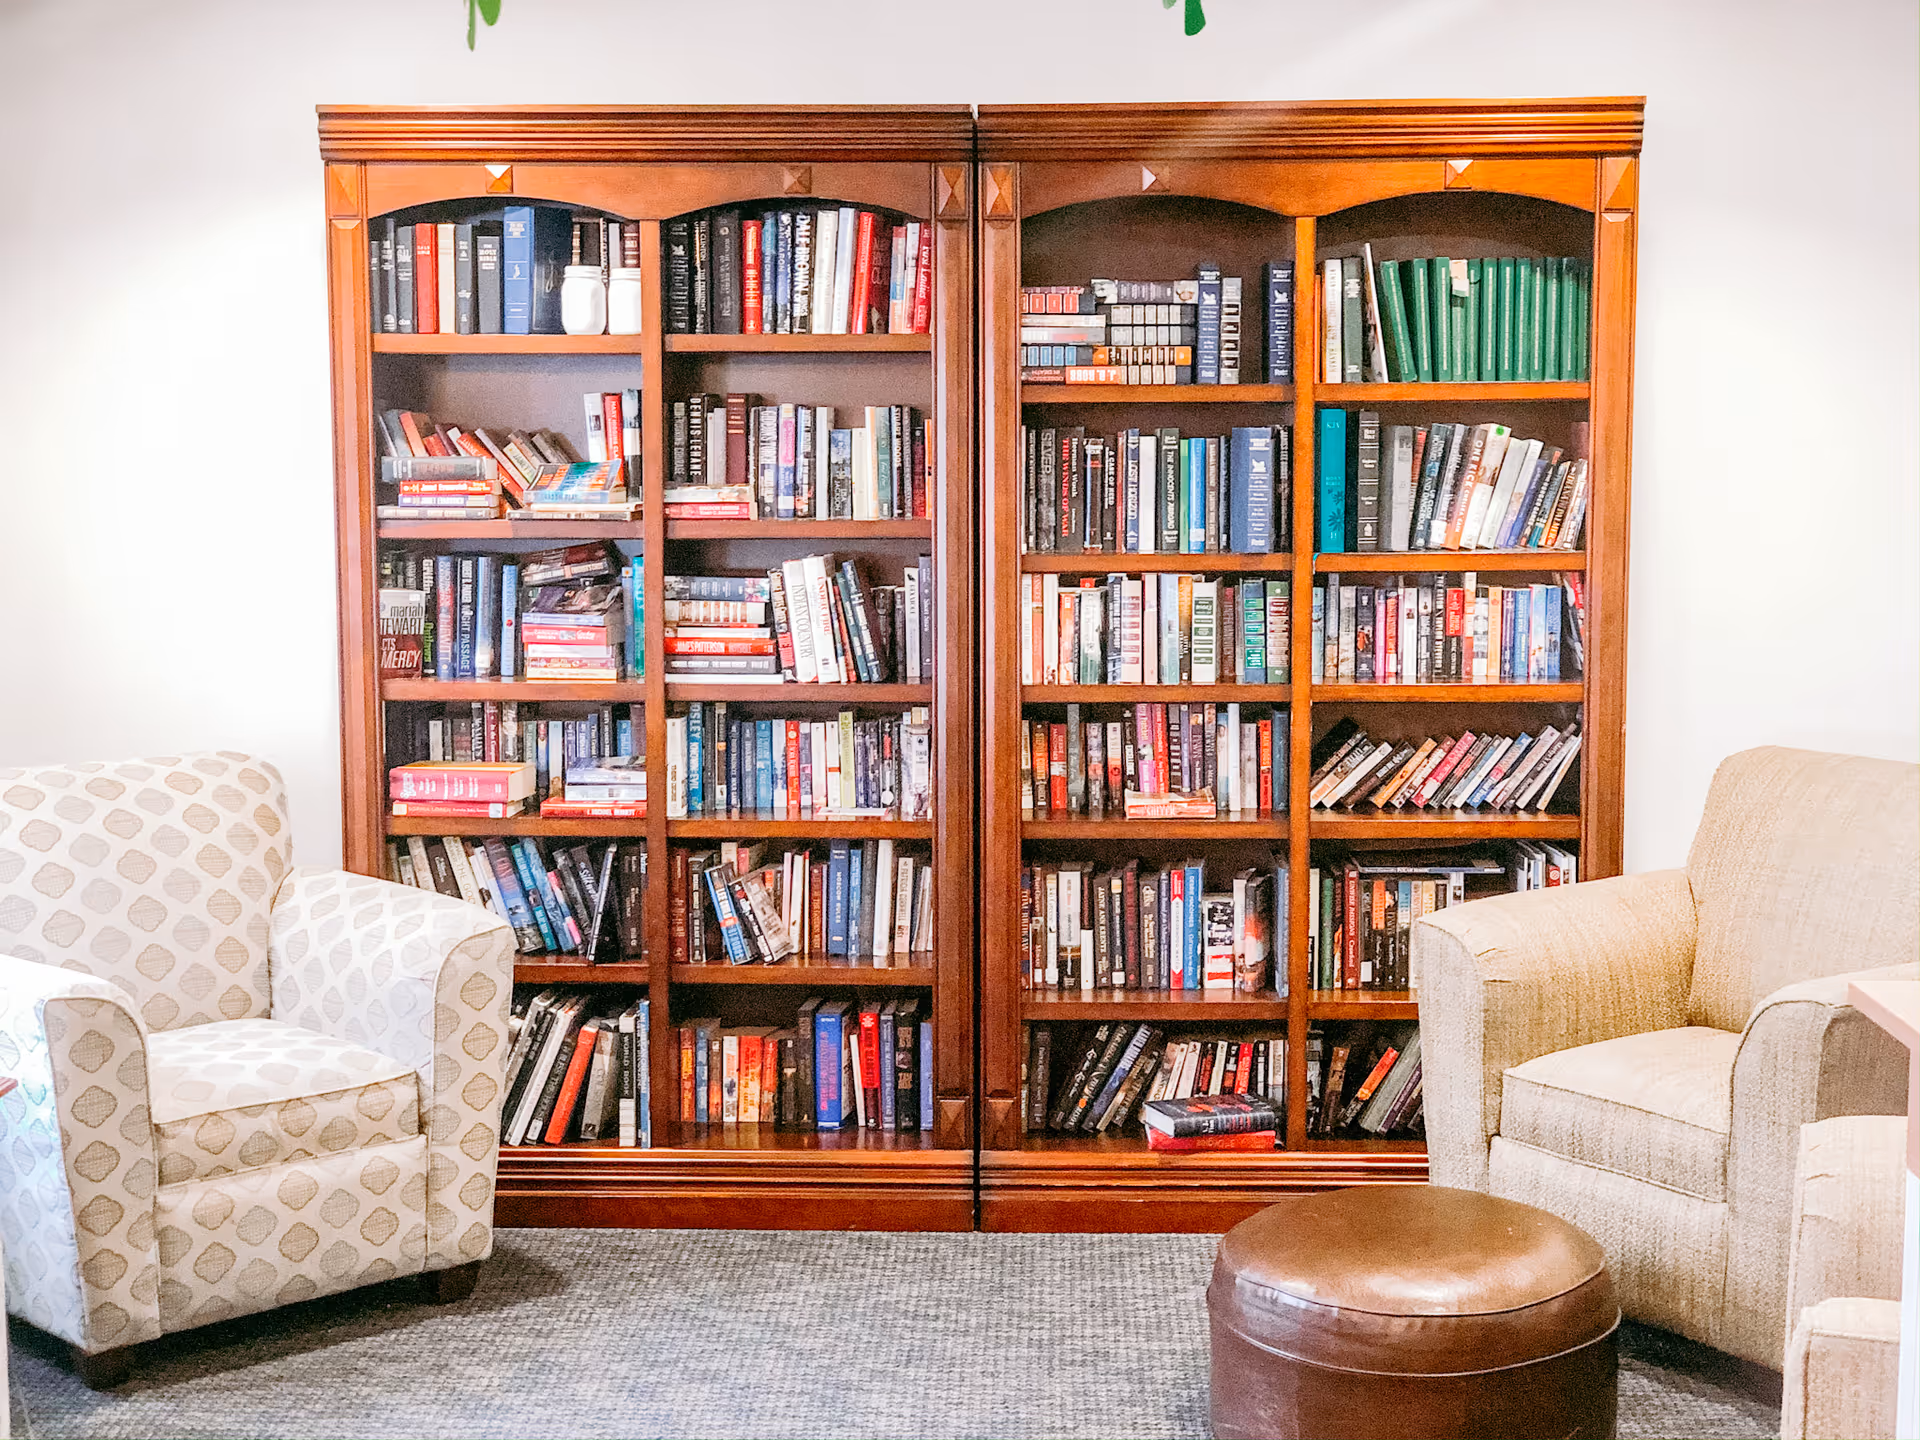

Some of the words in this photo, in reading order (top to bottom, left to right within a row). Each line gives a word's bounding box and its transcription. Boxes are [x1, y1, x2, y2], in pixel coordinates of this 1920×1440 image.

[796, 216, 811, 243] DALE
[795, 247, 810, 291] BROWN
[919, 268, 931, 300] Ladies
[1070, 369, 1096, 382] ROBB
[610, 401, 618, 418] MARY
[690, 398, 702, 436] DENNIS
[690, 439, 702, 476] LEHANE
[1040, 432, 1052, 474] SILVER
[1167, 451, 1176, 463] THE
[1280, 450, 1288, 460] LEE
[1472, 440, 1484, 461] ONE
[1128, 460, 1138, 483] LOST
[1167, 464, 1176, 501] INNOCENTS
[1424, 477, 1432, 492] AND
[1464, 464, 1478, 488] KICK
[1560, 474, 1575, 500] DIANA
[1062, 494, 1069, 511] OF
[1128, 486, 1138, 520] HORIZON
[1418, 492, 1430, 531] DANGEROUS
[1426, 500, 1434, 519] CLOSE
[1459, 489, 1470, 516] CHELSEA
[1166, 502, 1176, 530] ABROAD
[1548, 508, 1565, 539] PALMER
[461, 560, 474, 578] ROBERT
[1436, 576, 1444, 586] THE
[461, 584, 473, 603] PARKER
[792, 584, 808, 616] INDIAN
[817, 576, 828, 611] UNDER
[390, 603, 422, 618] mariah
[460, 604, 474, 632] NIGHT
[822, 614, 832, 636] FIRE
[1436, 616, 1444, 639] TAYLOR
[423, 622, 434, 663] Outlaws
[460, 634, 470, 670] PASSAGE
[676, 640, 694, 652] JAMES
[694, 640, 725, 653] PATTERSON
[796, 619, 814, 659] COUNTRY
[380, 651, 421, 669] MERCY
[1436, 641, 1444, 667] STEVENS
[1140, 717, 1148, 740] Pratchett
[1156, 722, 1164, 752] MACOMBER
[1262, 730, 1270, 745] RAIN
[690, 742, 699, 770] KNOWN
[1262, 748, 1270, 766] DOGS
[690, 773, 698, 790] EVIL
[1021, 890, 1030, 909] TOM
[1098, 887, 1106, 908] JAYNE
[1348, 880, 1356, 906] UNWISE
[1098, 909, 1106, 923] ANN
[1348, 907, 1356, 936] PASSIONS
[1099, 924, 1107, 953] KRENTZ
[1348, 939, 1356, 968] Crawford
